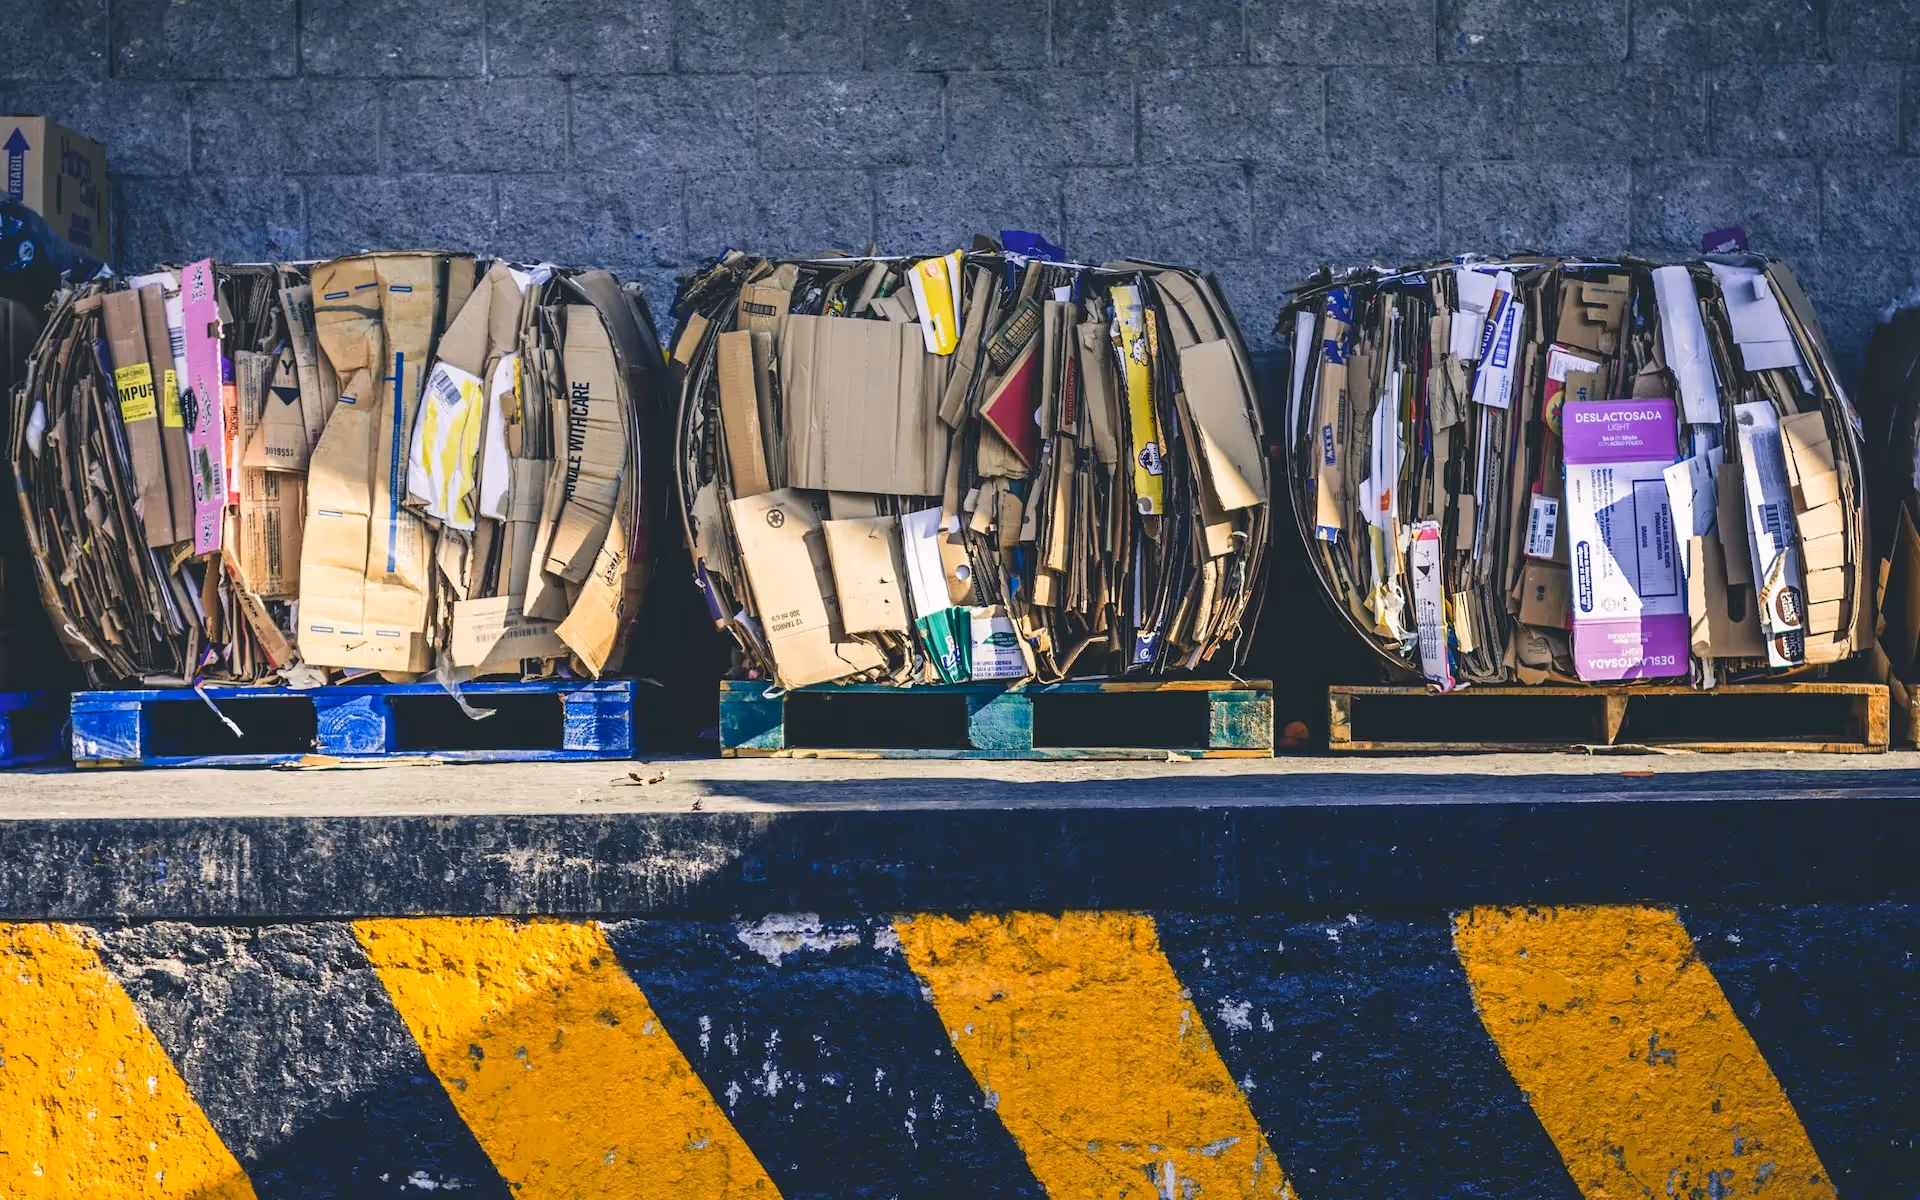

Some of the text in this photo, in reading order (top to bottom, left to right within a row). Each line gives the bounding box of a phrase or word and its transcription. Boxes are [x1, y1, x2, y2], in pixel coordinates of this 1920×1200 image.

[10, 154, 22, 194] FRAGIL
[569, 381, 591, 417] CARE
[1575, 411, 1662, 422] DESLACTOSADA
[1608, 423, 1630, 431] LIGHT
[1780, 592, 1791, 623] Gusto
[1588, 655, 1674, 668] DESLACTOSADA
